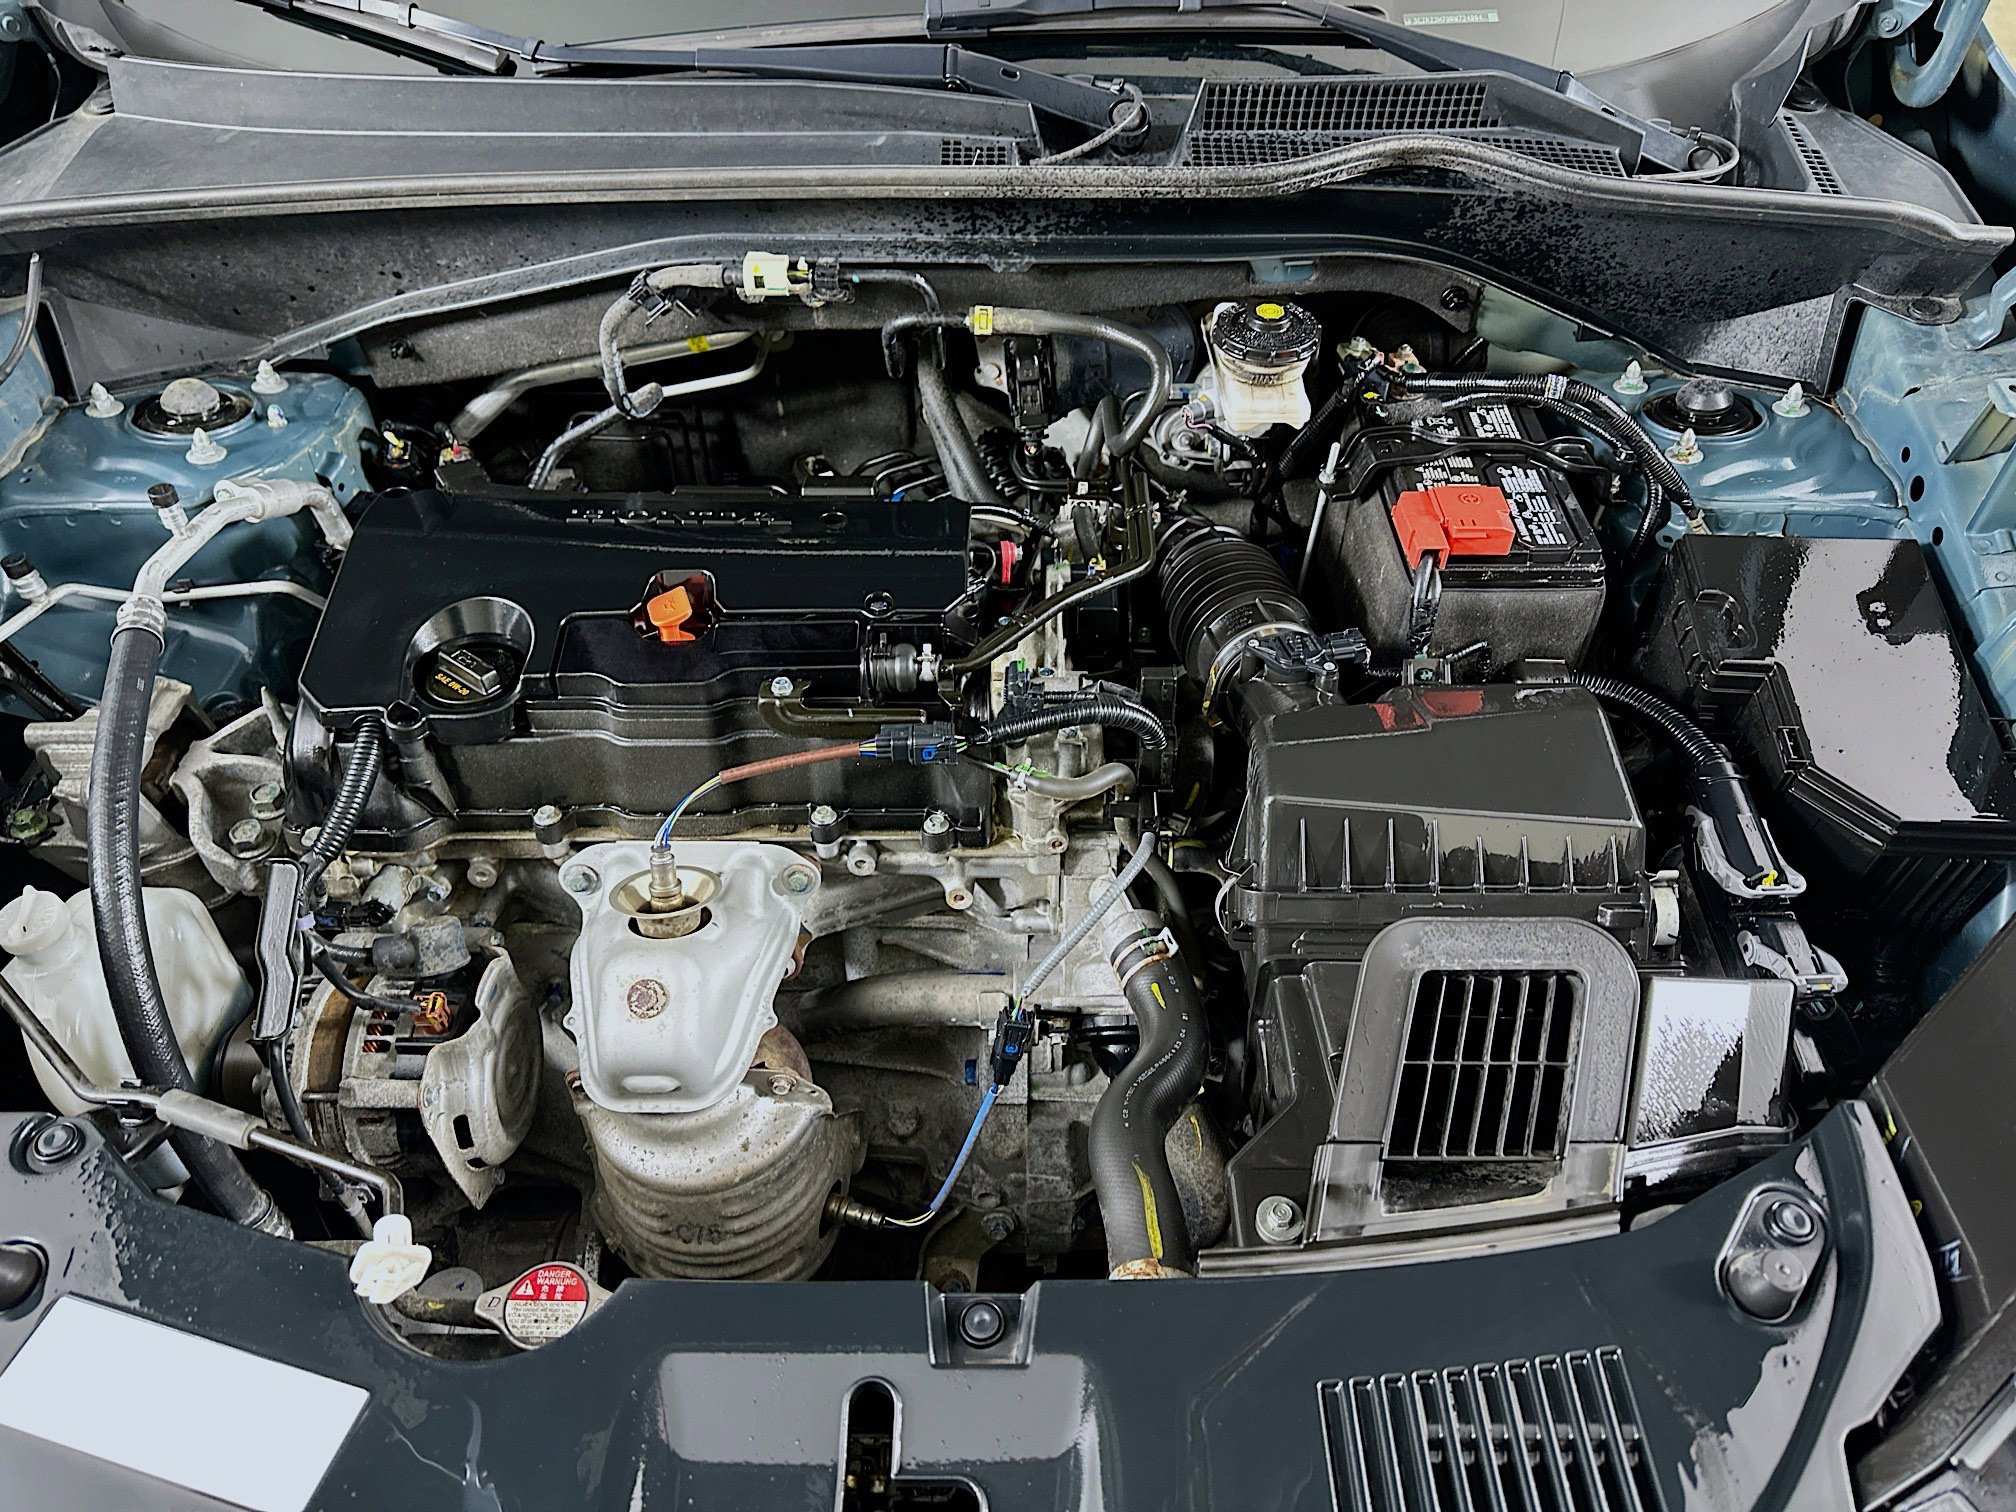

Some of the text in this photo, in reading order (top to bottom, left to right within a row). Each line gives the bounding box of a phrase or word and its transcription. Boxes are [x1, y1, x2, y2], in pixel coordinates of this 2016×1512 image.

[435, 674, 469, 695] SAE 0W-20
[1122, 1109, 1129, 1119] C2
[1173, 1040, 1183, 1050] 23
[536, 1277, 578, 1286] WARNUNG
[538, 1270, 572, 1278] DANGER
